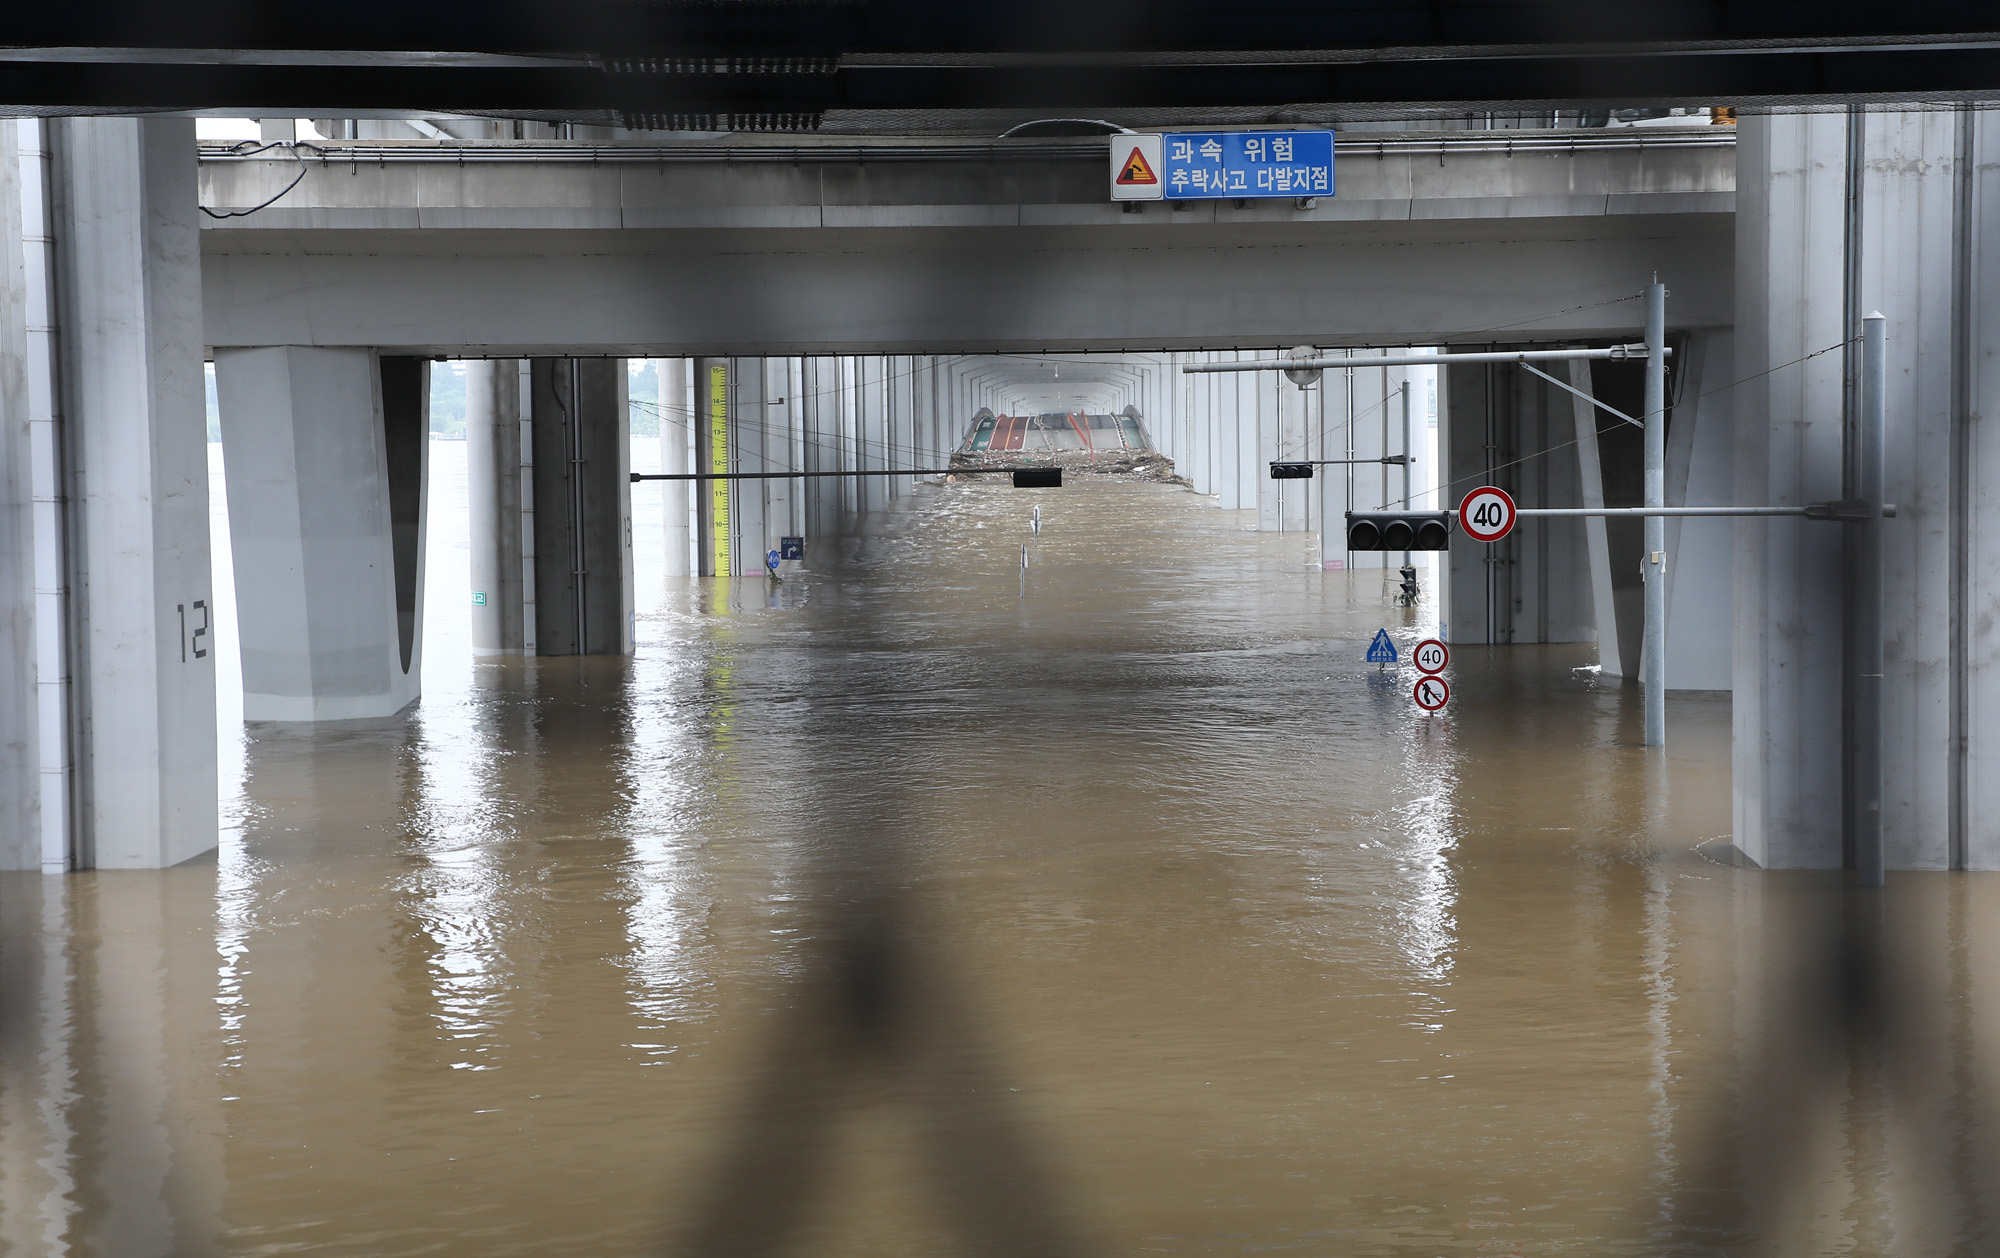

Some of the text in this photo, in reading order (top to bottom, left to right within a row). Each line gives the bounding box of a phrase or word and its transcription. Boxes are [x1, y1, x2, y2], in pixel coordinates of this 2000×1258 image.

[1171, 136, 1293, 164] 과속 위험
[1171, 165, 1328, 193] 추락사고 다발지점
[1473, 502, 1502, 527] 40
[177, 600, 208, 663] 12
[1421, 649, 1441, 664] 40
